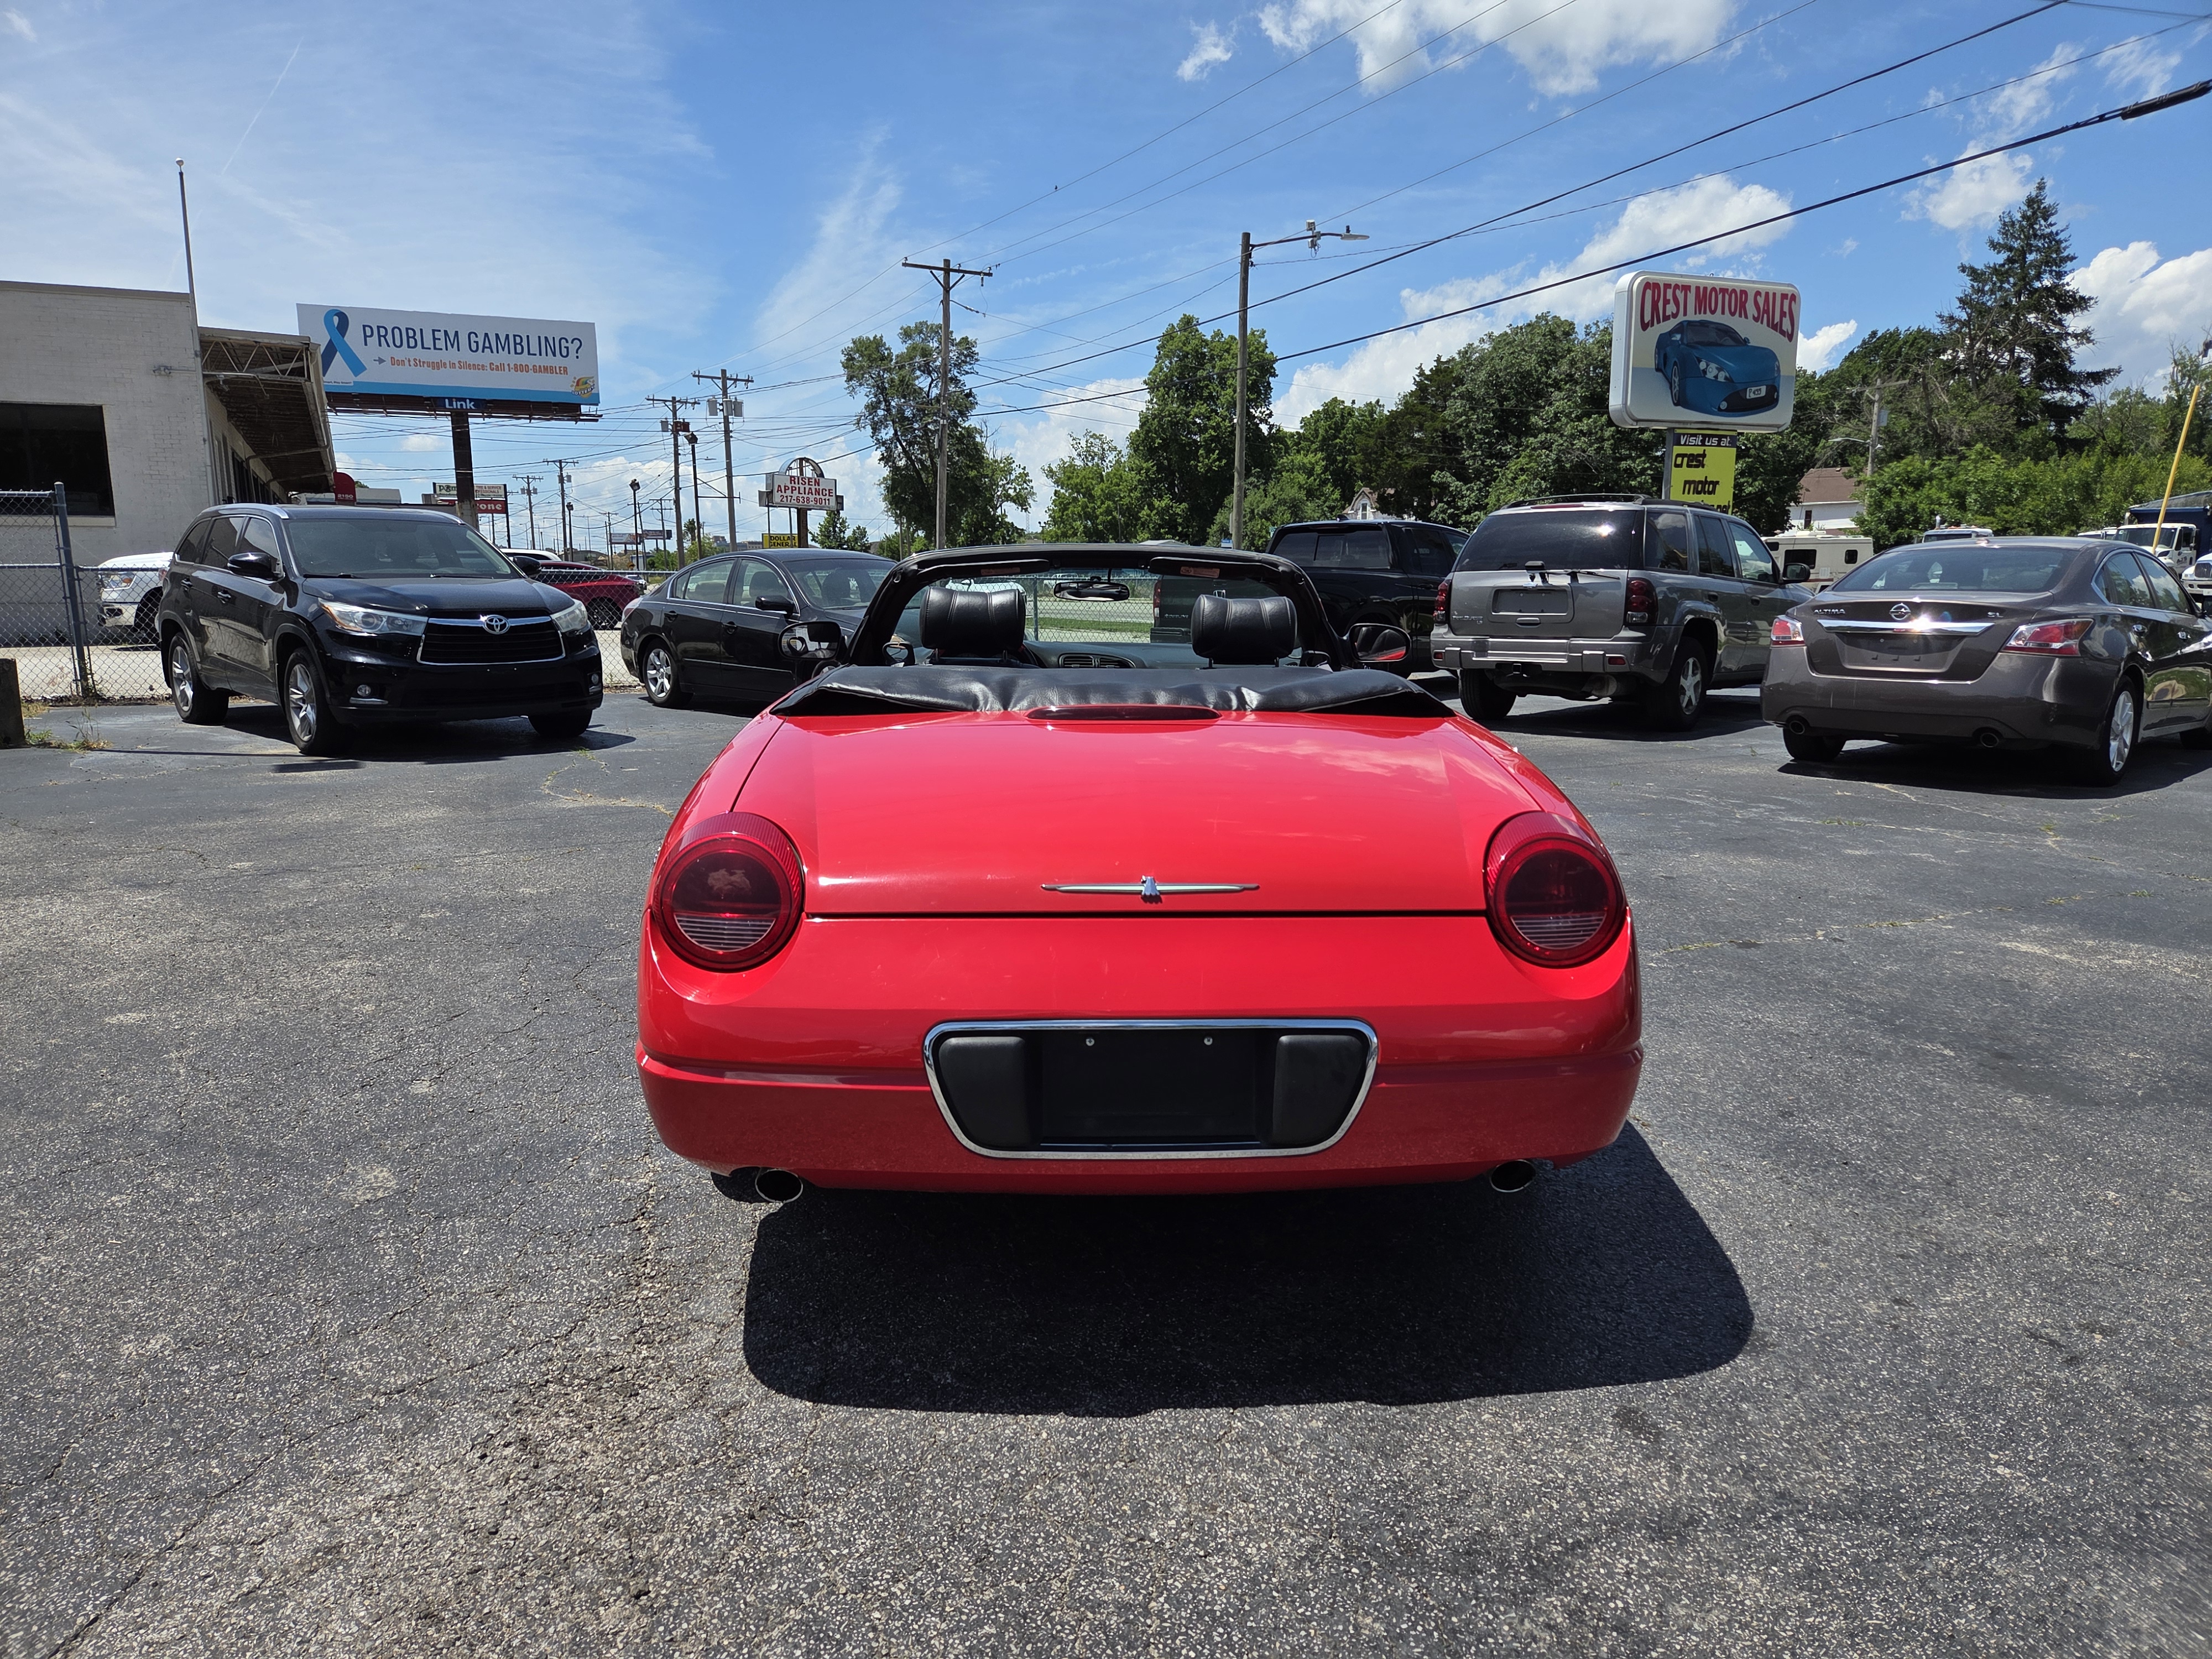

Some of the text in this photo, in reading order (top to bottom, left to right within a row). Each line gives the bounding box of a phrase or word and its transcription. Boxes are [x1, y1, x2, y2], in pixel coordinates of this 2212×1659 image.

[1640, 281, 1797, 343] CREST MOTOR SALES
[362, 324, 583, 359] PROBLEM GAMBLING?
[390, 356, 411, 367] Don't
[413, 357, 447, 371] Struggle
[458, 360, 488, 371] Silence:
[489, 362, 505, 372] Call
[507, 363, 568, 375] 1-800-GAMBLER
[571, 383, 596, 396] LOTTERY
[445, 398, 476, 409] Link
[1681, 435, 1703, 445] Visit
[1705, 437, 1718, 446] us
[1673, 448, 1707, 469] crest
[789, 476, 820, 487] RISEN
[1682, 476, 1720, 495] motor
[776, 484, 833, 497] APPLIANCE
[780, 494, 830, 505] 217-638-9011
